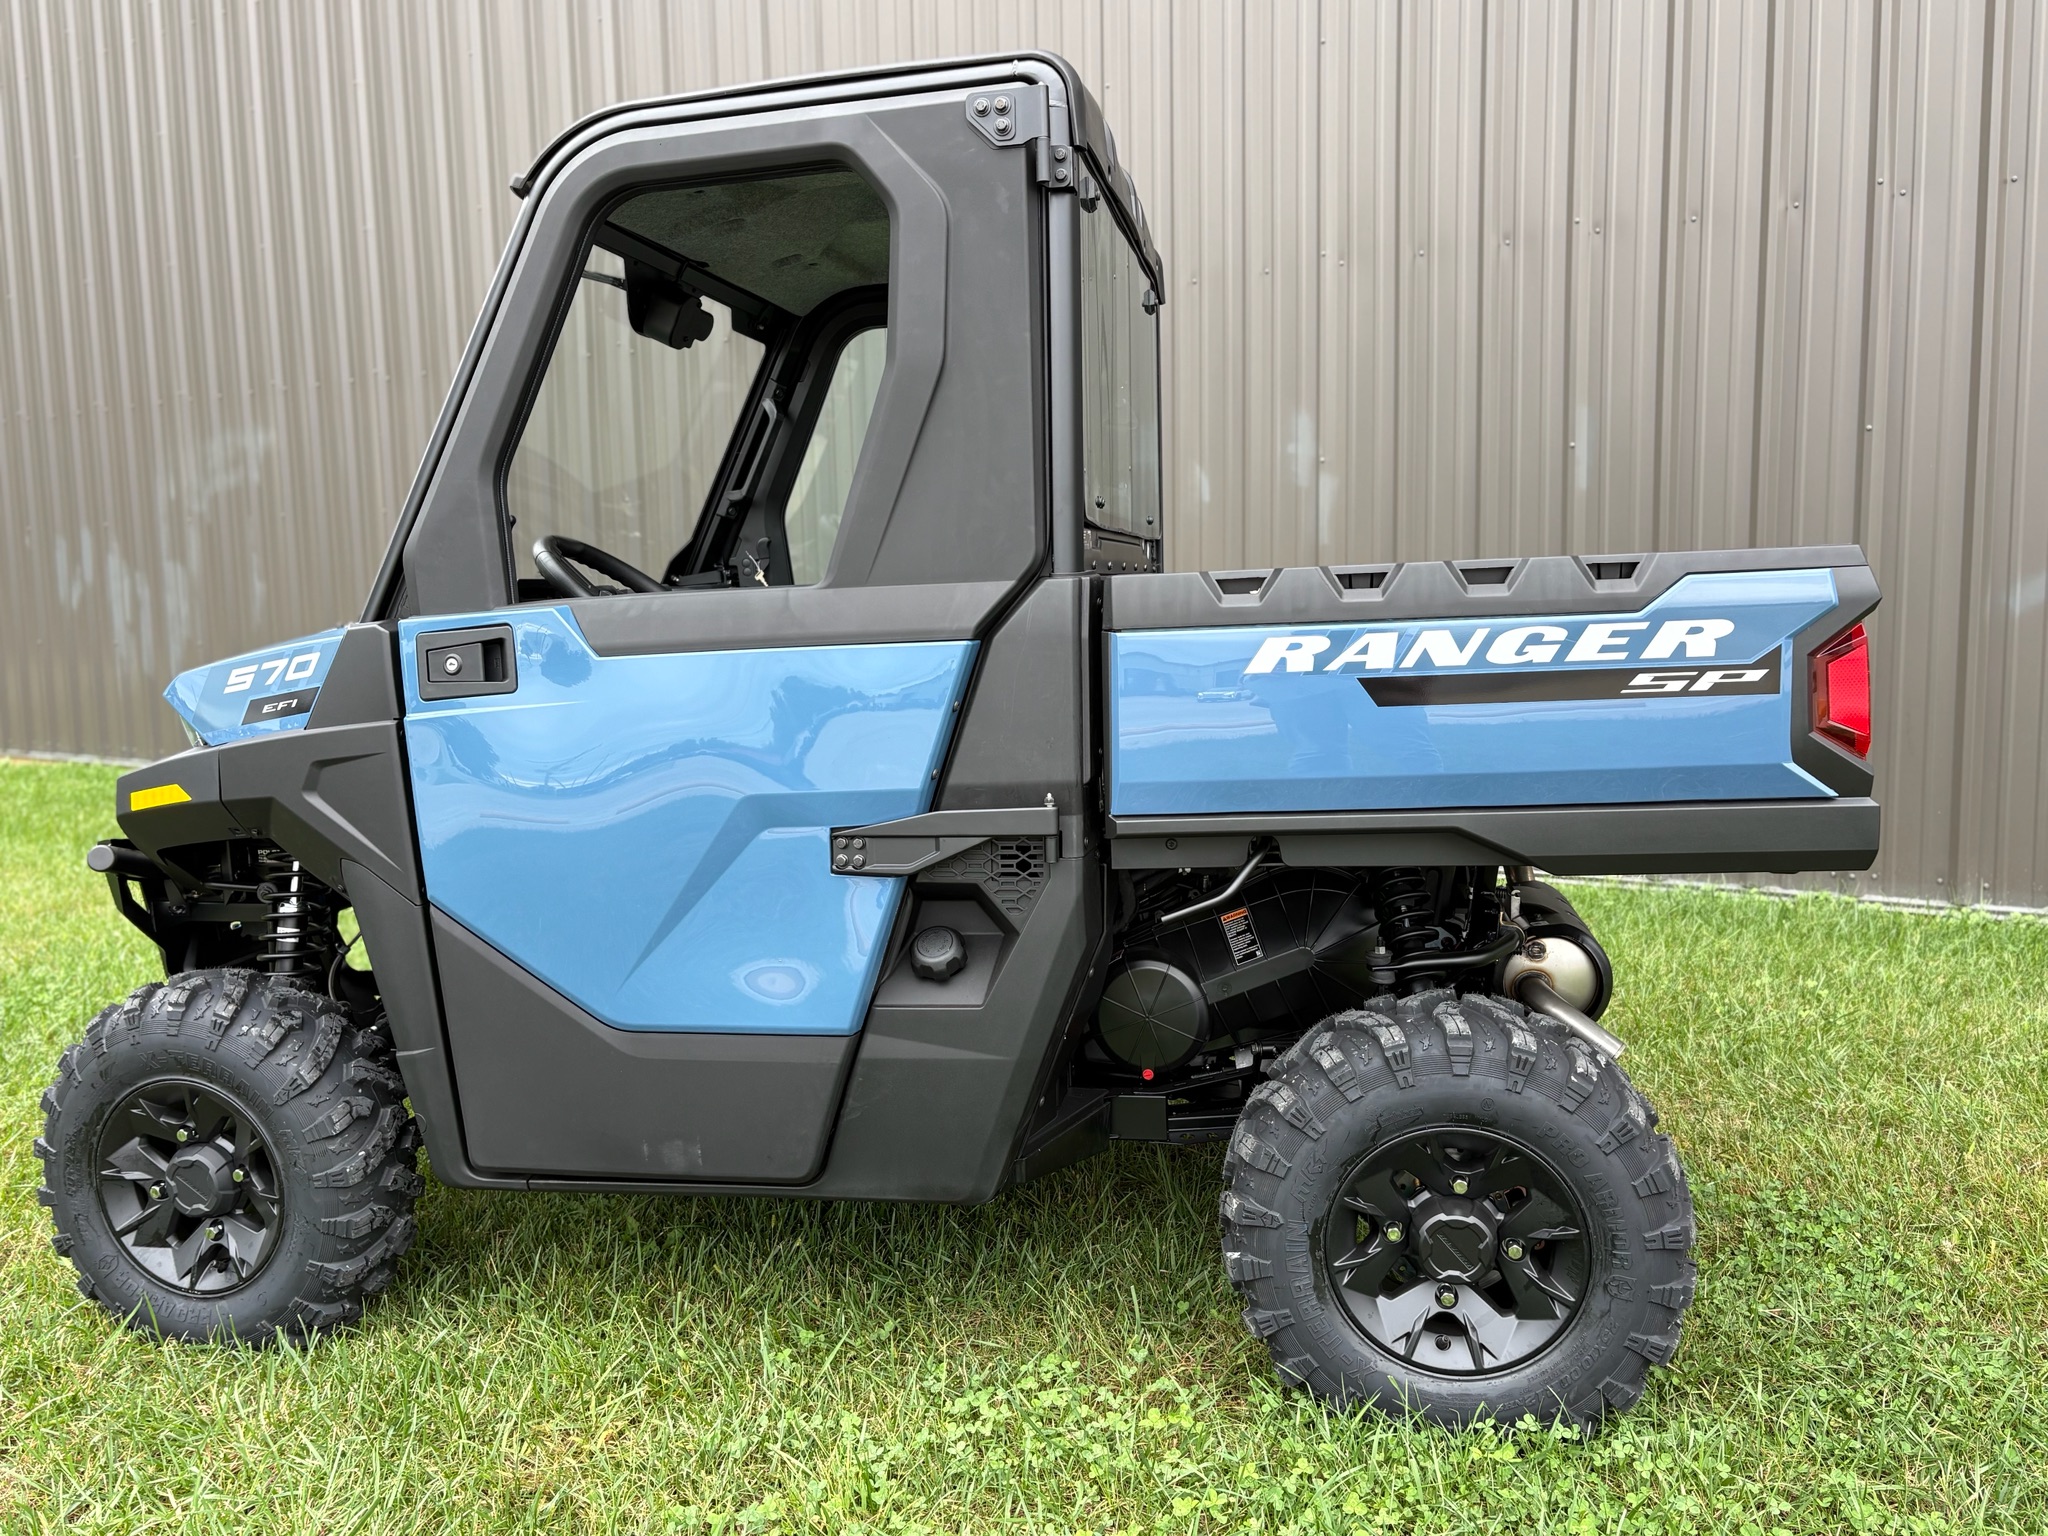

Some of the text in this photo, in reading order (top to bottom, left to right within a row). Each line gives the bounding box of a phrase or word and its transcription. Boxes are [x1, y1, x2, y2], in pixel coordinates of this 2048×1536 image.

[223, 652, 321, 694] 570
[1244, 619, 1735, 674] RANGER
[261, 698, 298, 714] EFI
[1620, 668, 1770, 694] SP
[138, 1050, 275, 1121] X-TERRAIN
[1536, 1121, 1633, 1270] PRO ARMOR
[1286, 1219, 1377, 1381] X-TERRAIN
